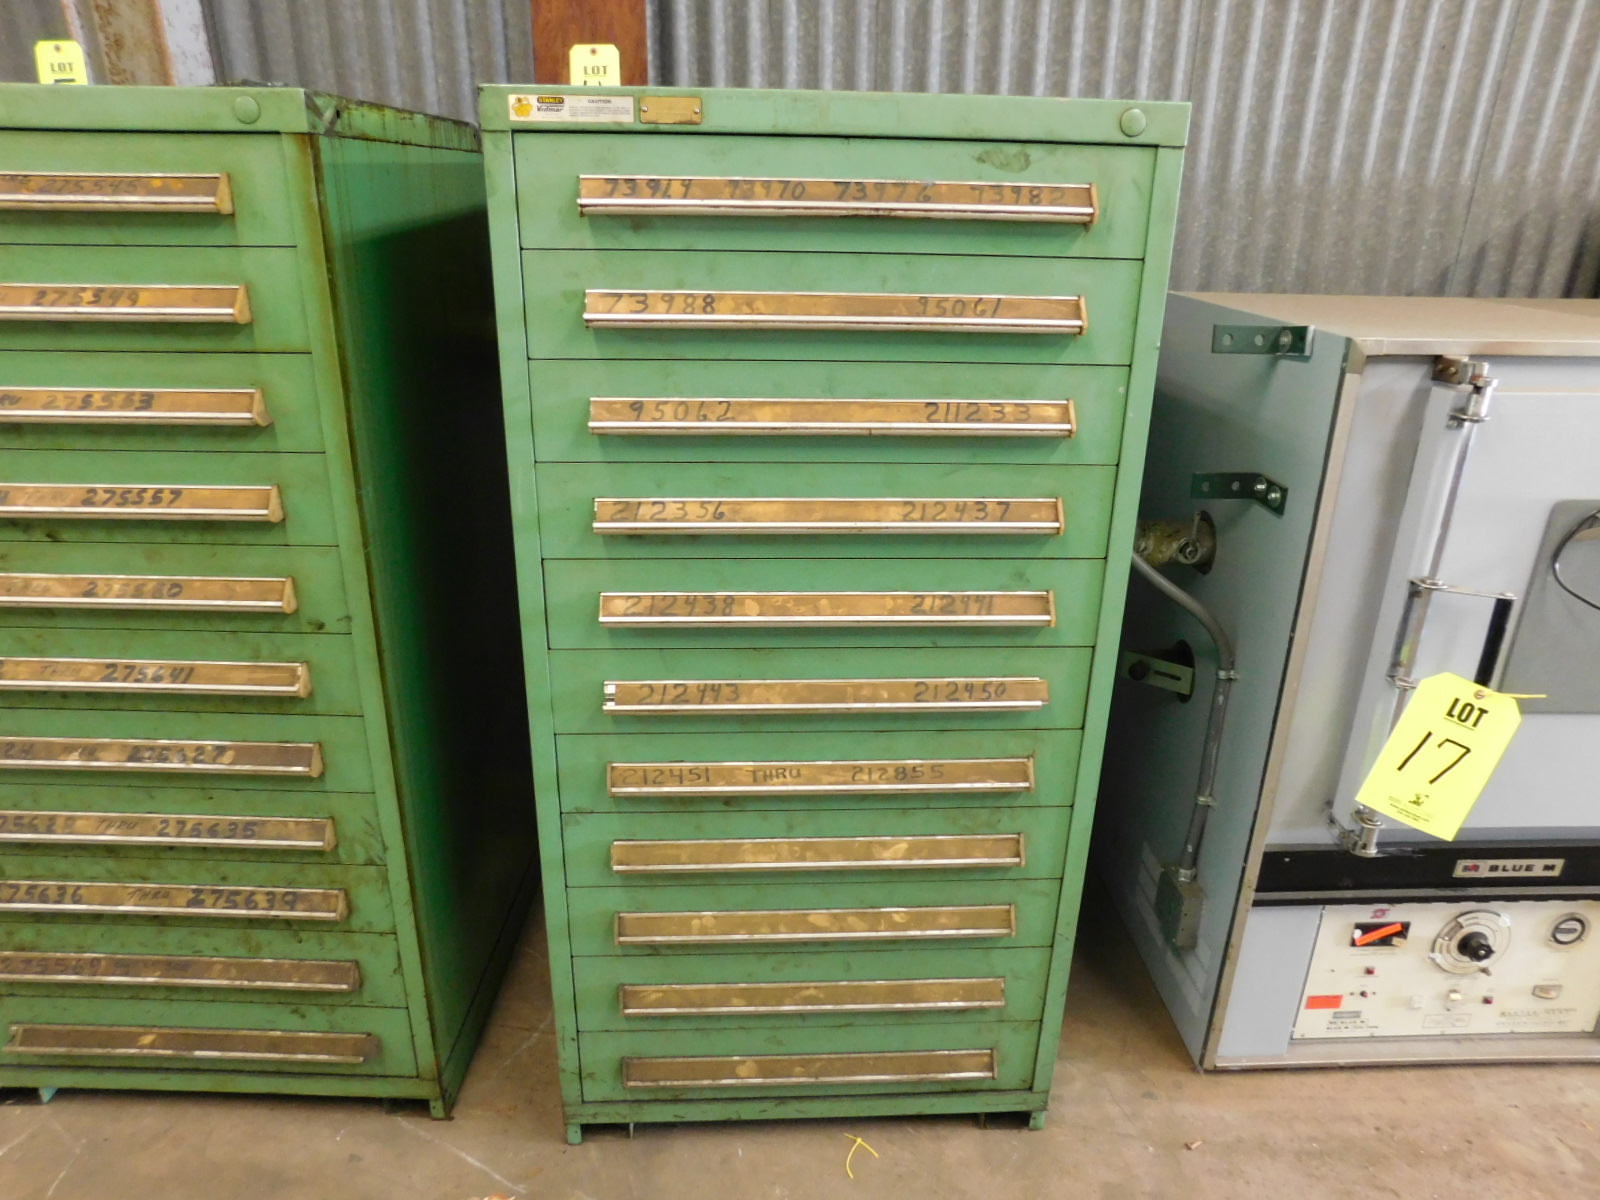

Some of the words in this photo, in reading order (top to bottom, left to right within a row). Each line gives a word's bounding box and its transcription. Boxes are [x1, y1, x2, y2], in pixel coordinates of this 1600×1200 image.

[49, 62, 74, 72] LOT
[583, 65, 608, 75] LOT
[600, 292, 716, 314] 73988
[918, 296, 1001, 318] 95061
[629, 400, 735, 422] 95062
[924, 402, 1031, 423] 211233
[610, 501, 726, 521] 212356
[902, 500, 1011, 522] 212437
[623, 595, 735, 616] 212438
[637, 682, 741, 705] 212443
[914, 681, 1007, 702] 212450
[1446, 697, 1490, 728] LOT
[1397, 731, 1472, 785] 17
[621, 766, 710, 785] 212451
[746, 768, 802, 783] THRU
[851, 764, 945, 782] 212855
[1487, 863, 1536, 872] BLUE
[1542, 863, 1557, 872] M
[0, 885, 83, 904] 75636
